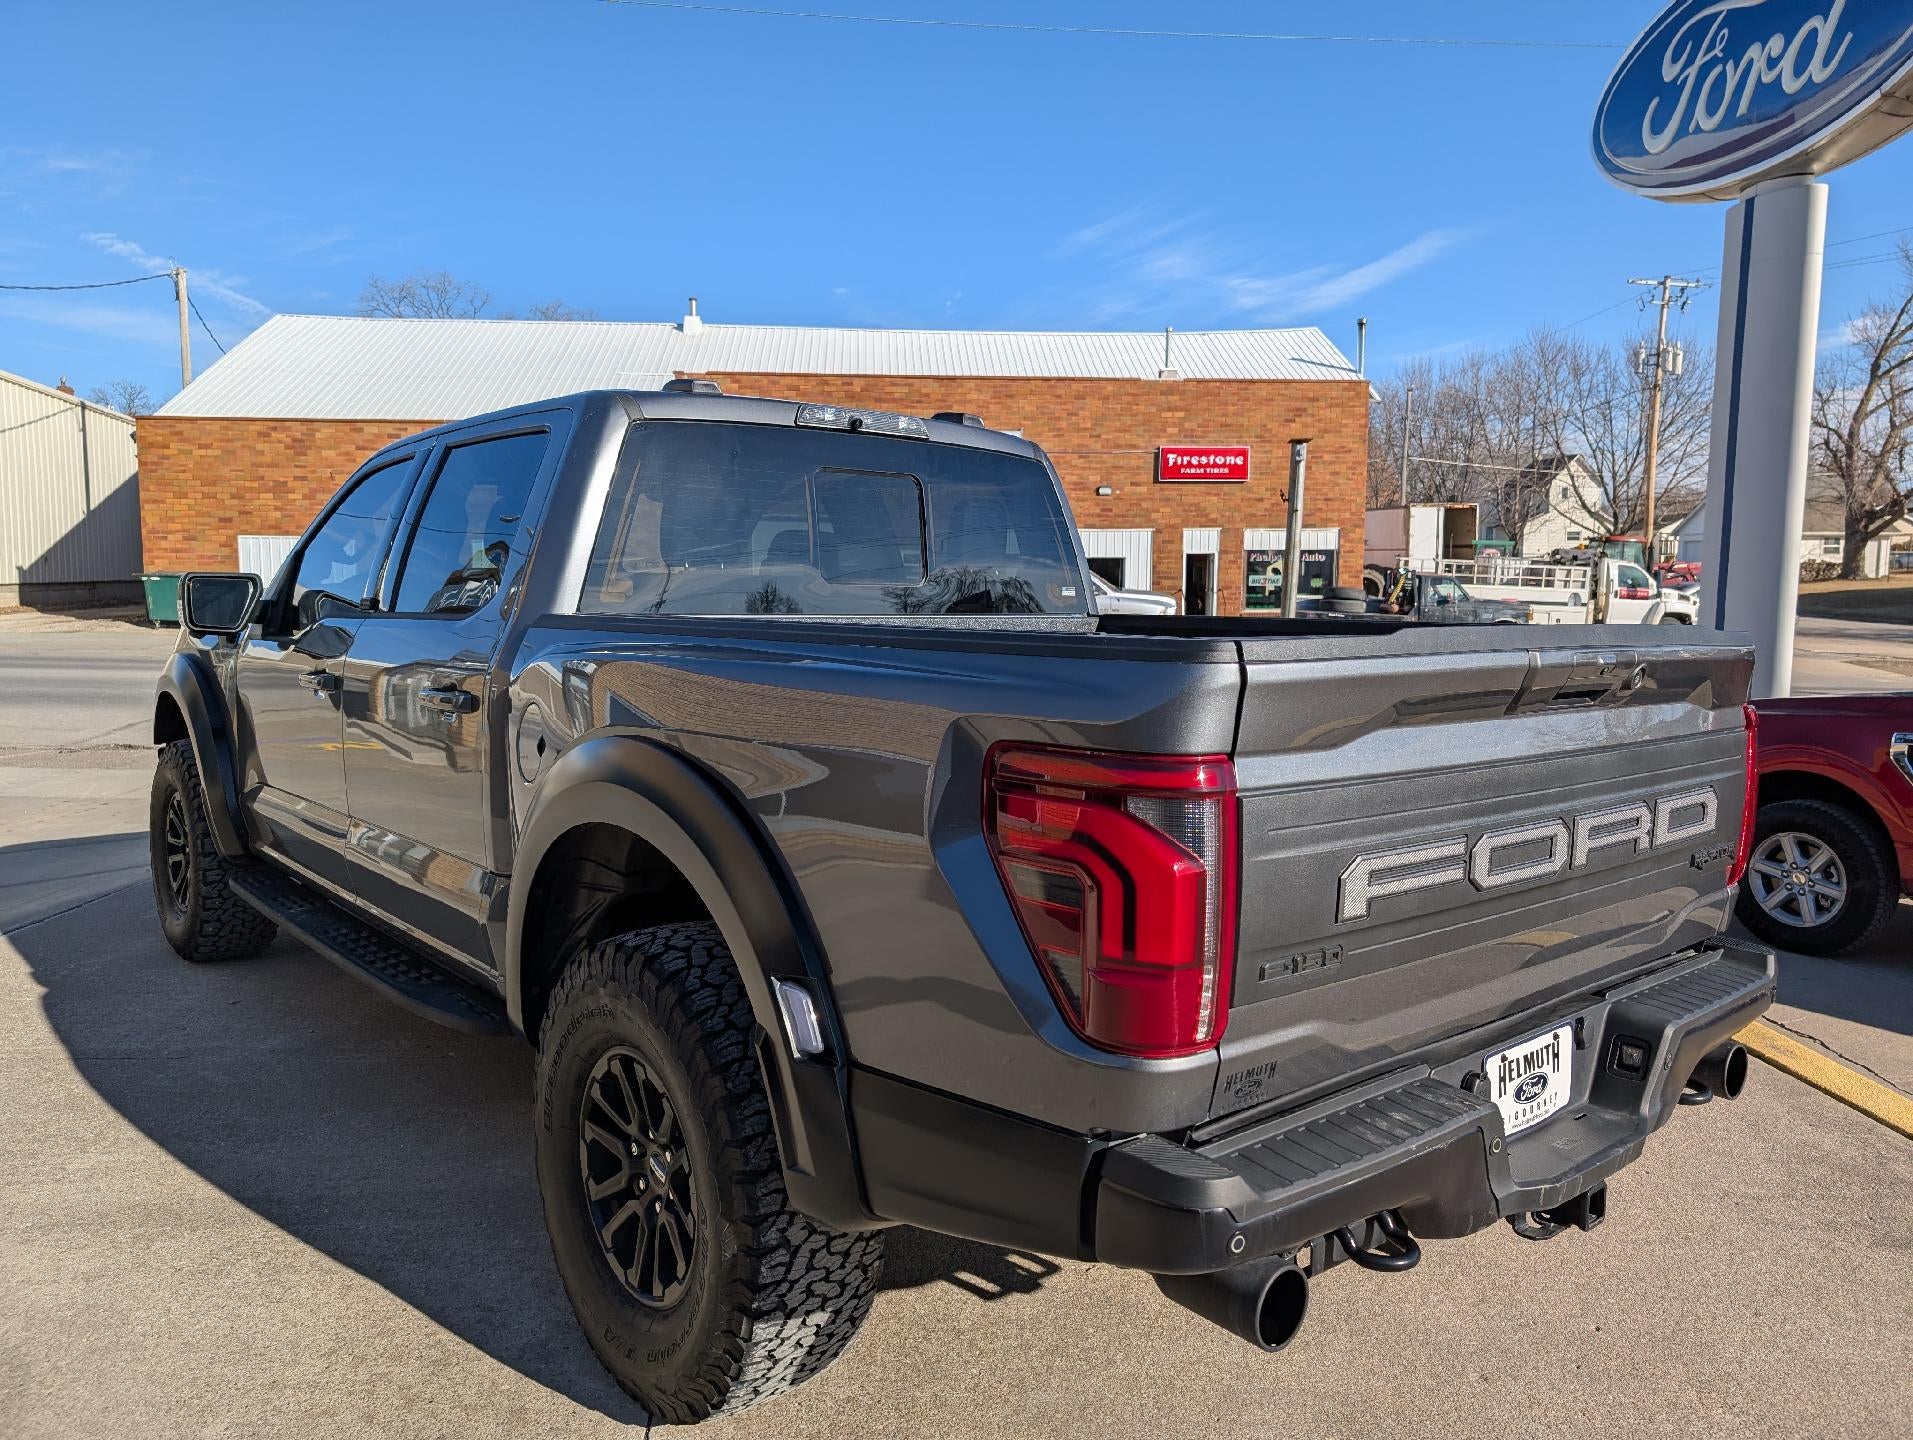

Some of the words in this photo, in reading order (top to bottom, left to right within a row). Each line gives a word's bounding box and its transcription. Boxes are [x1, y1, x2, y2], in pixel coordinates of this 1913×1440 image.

[1642, 0, 1854, 155] Ford
[1166, 453, 1244, 467] Firestone
[1301, 552, 1327, 562] Auto
[1335, 785, 1719, 924] FORD
[1223, 1060, 1278, 1095] HELMUTH
[1498, 1040, 1560, 1100] HELMUTH
[1520, 1076, 1545, 1101] Ford
